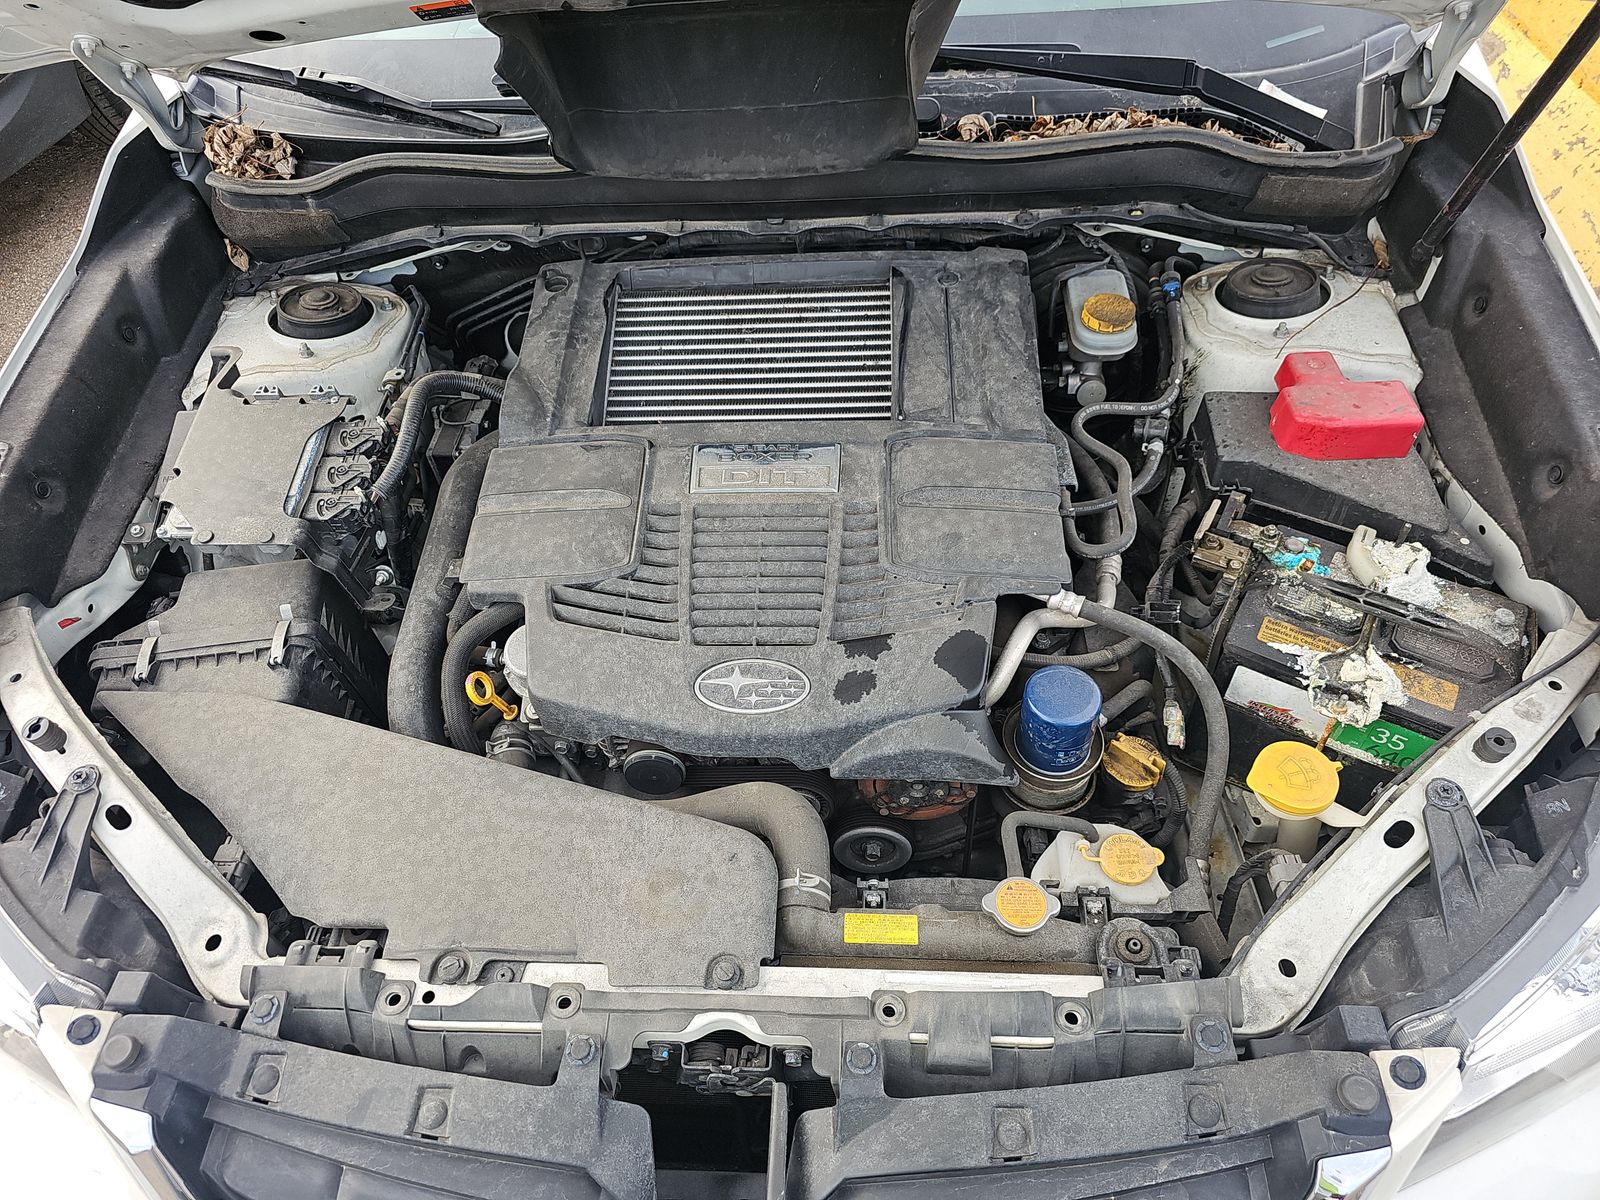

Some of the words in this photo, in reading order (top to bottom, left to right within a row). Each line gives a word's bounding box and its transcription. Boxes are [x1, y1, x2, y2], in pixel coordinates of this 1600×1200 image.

[717, 452, 813, 463] BOXER
[721, 469, 807, 484] DIT
[1264, 624, 1292, 638] batteries
[1299, 637, 1321, 649] Costco
[1266, 618, 1288, 630] Return
[1287, 626, 1316, 641] warranty
[1316, 637, 1330, 645] and
[1370, 727, 1409, 751] 35
